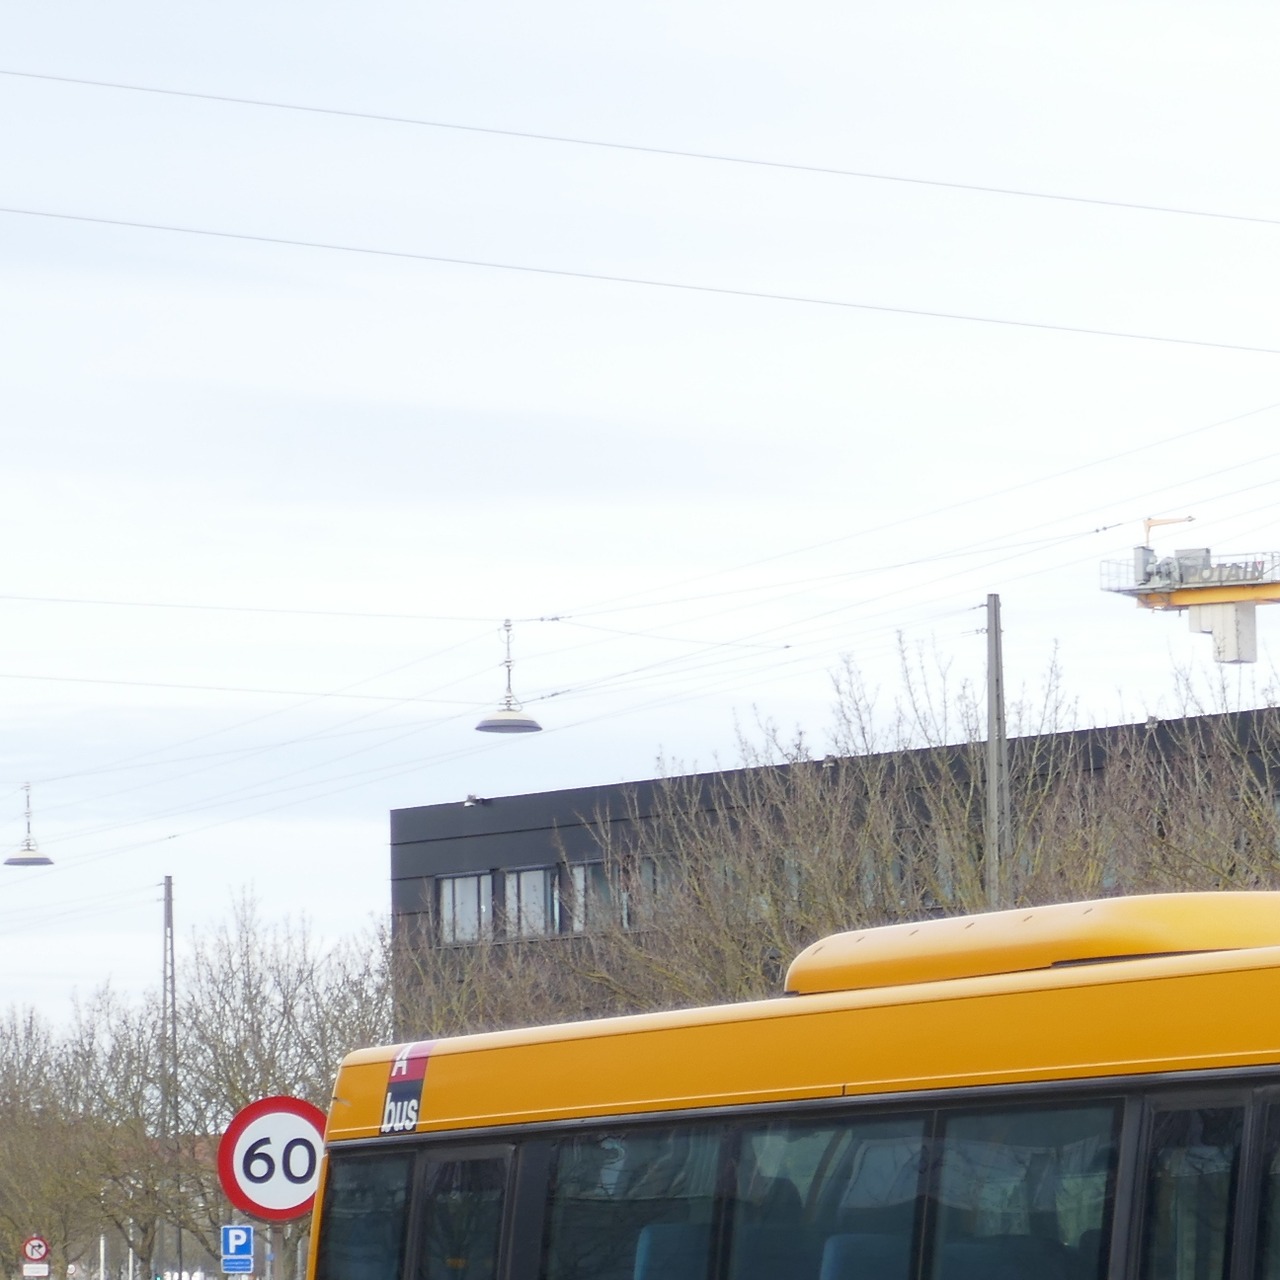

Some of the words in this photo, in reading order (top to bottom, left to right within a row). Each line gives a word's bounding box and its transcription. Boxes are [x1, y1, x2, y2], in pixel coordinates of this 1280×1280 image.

[391, 1043, 416, 1077] A
[381, 1092, 419, 1133] bus
[242, 1137, 315, 1184] 60
[229, 1230, 247, 1253] P
